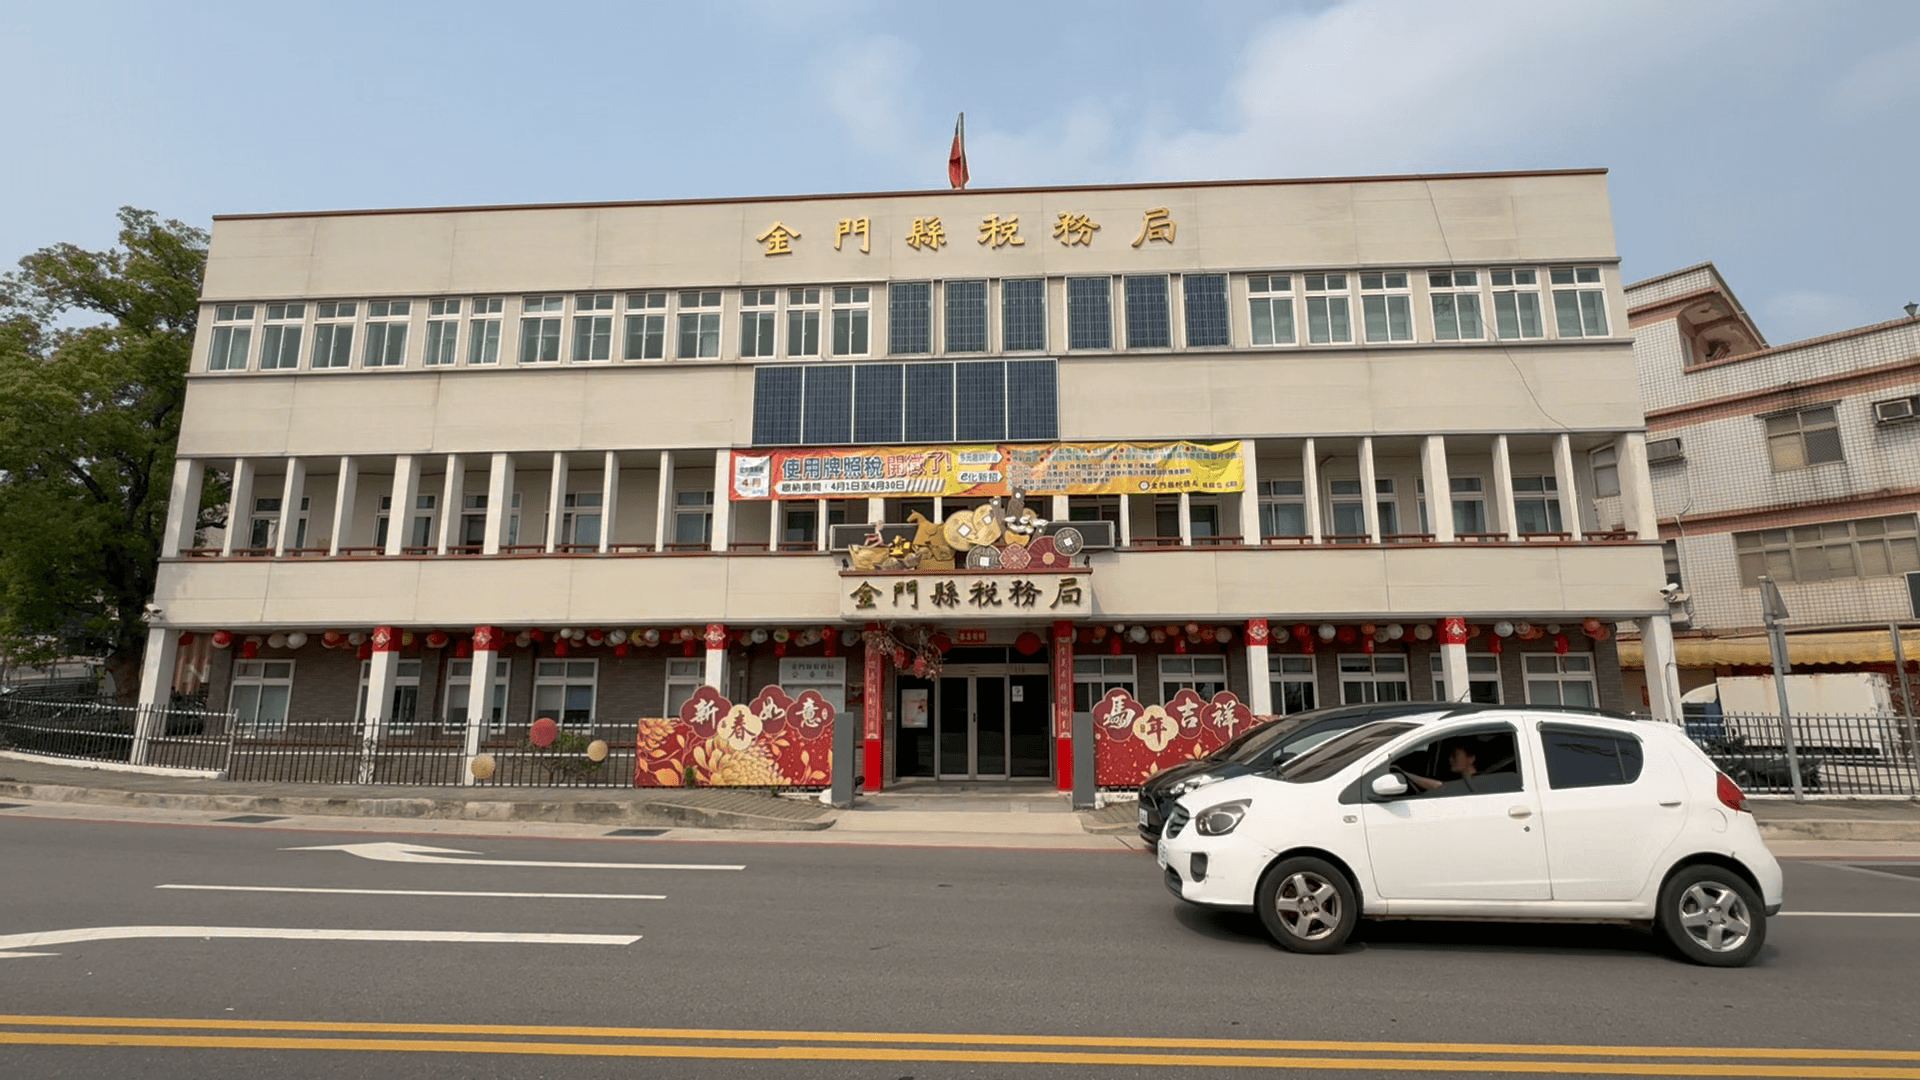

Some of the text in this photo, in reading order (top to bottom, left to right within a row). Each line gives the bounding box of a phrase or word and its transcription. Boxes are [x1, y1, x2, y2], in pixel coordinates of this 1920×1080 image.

[690, 695, 822, 740] 新春如意
[1103, 694, 1240, 747] 馬年吉祥
